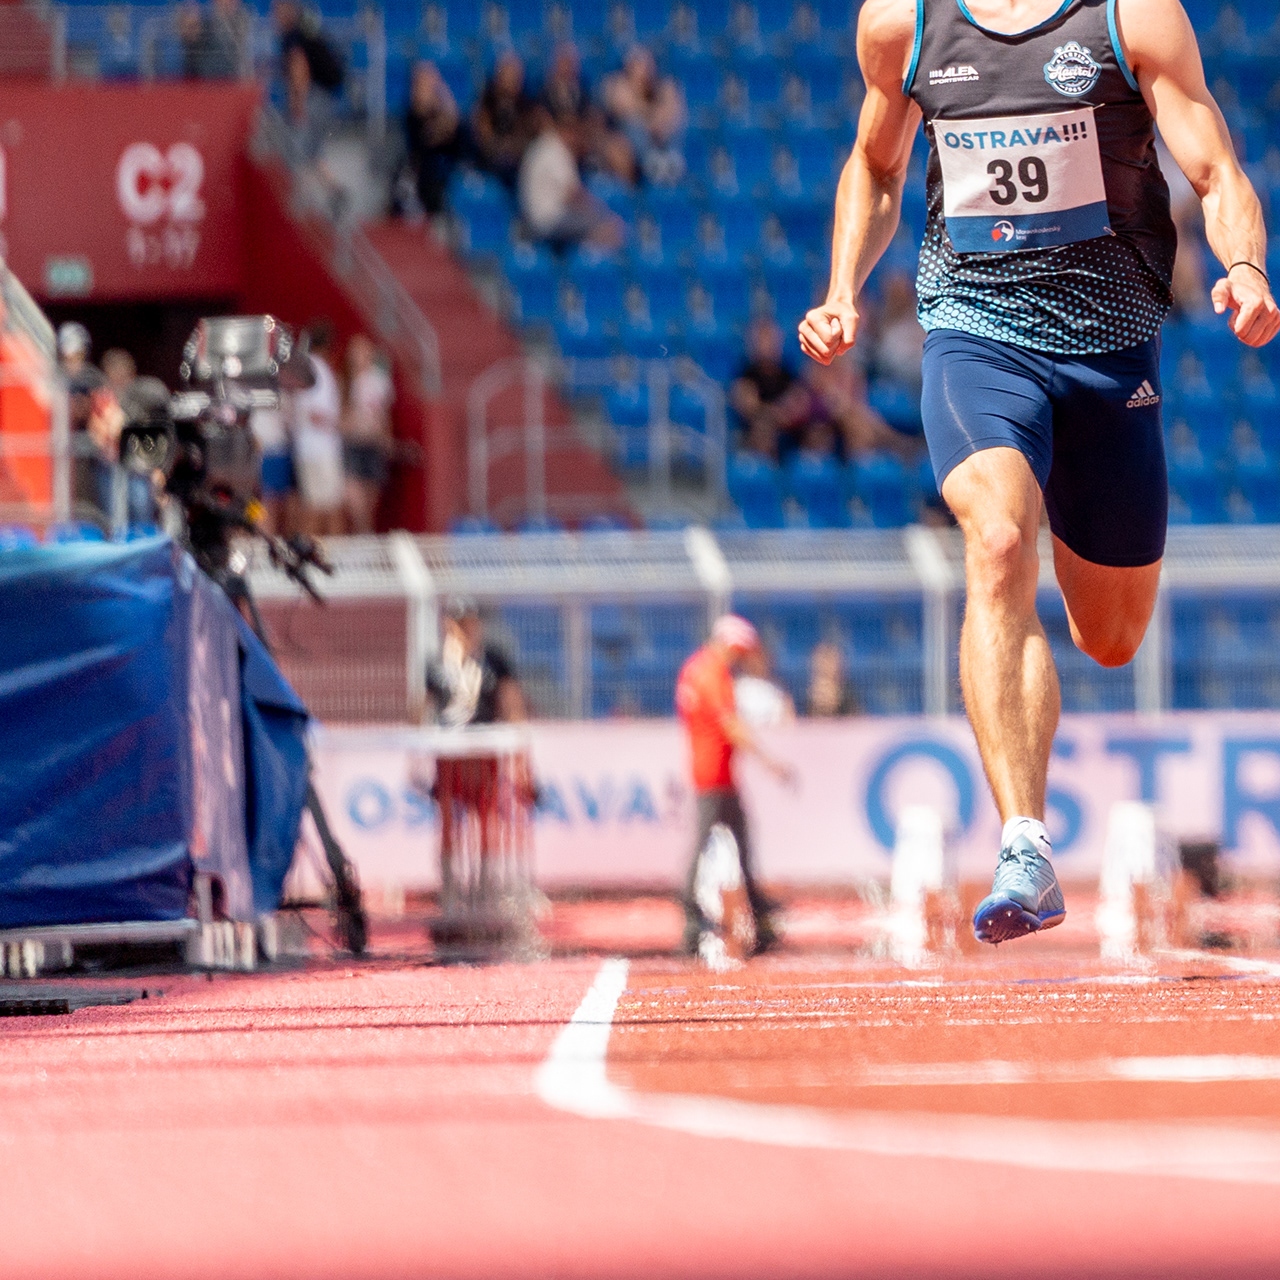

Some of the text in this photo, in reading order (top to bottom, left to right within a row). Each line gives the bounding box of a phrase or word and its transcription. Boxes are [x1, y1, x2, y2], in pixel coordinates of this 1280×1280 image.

[929, 75, 980, 86] SPORTSWEAR
[942, 65, 979, 78] ALEA
[944, 121, 1088, 150] OSTRAVA!!!
[114, 141, 205, 222] C2
[986, 156, 1049, 206] 39
[1126, 395, 1160, 409] adidas
